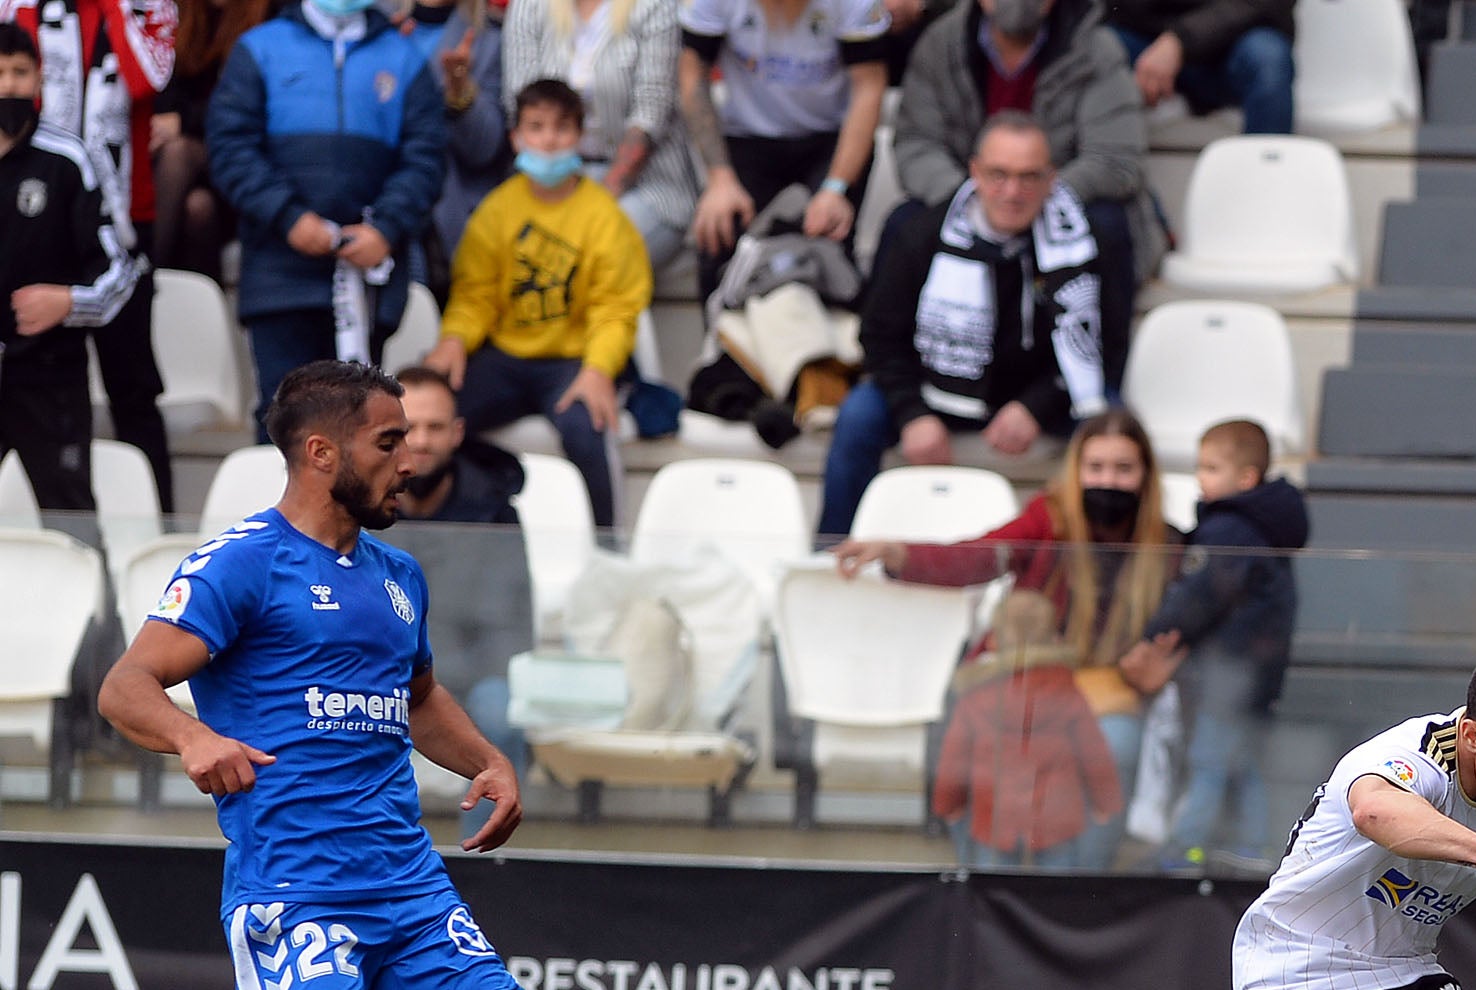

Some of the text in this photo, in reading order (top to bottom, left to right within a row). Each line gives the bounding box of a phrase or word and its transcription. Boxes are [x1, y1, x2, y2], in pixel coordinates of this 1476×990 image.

[304, 686, 410, 726] tenerif
[307, 718, 374, 731] despierta
[290, 922, 359, 983] 22
